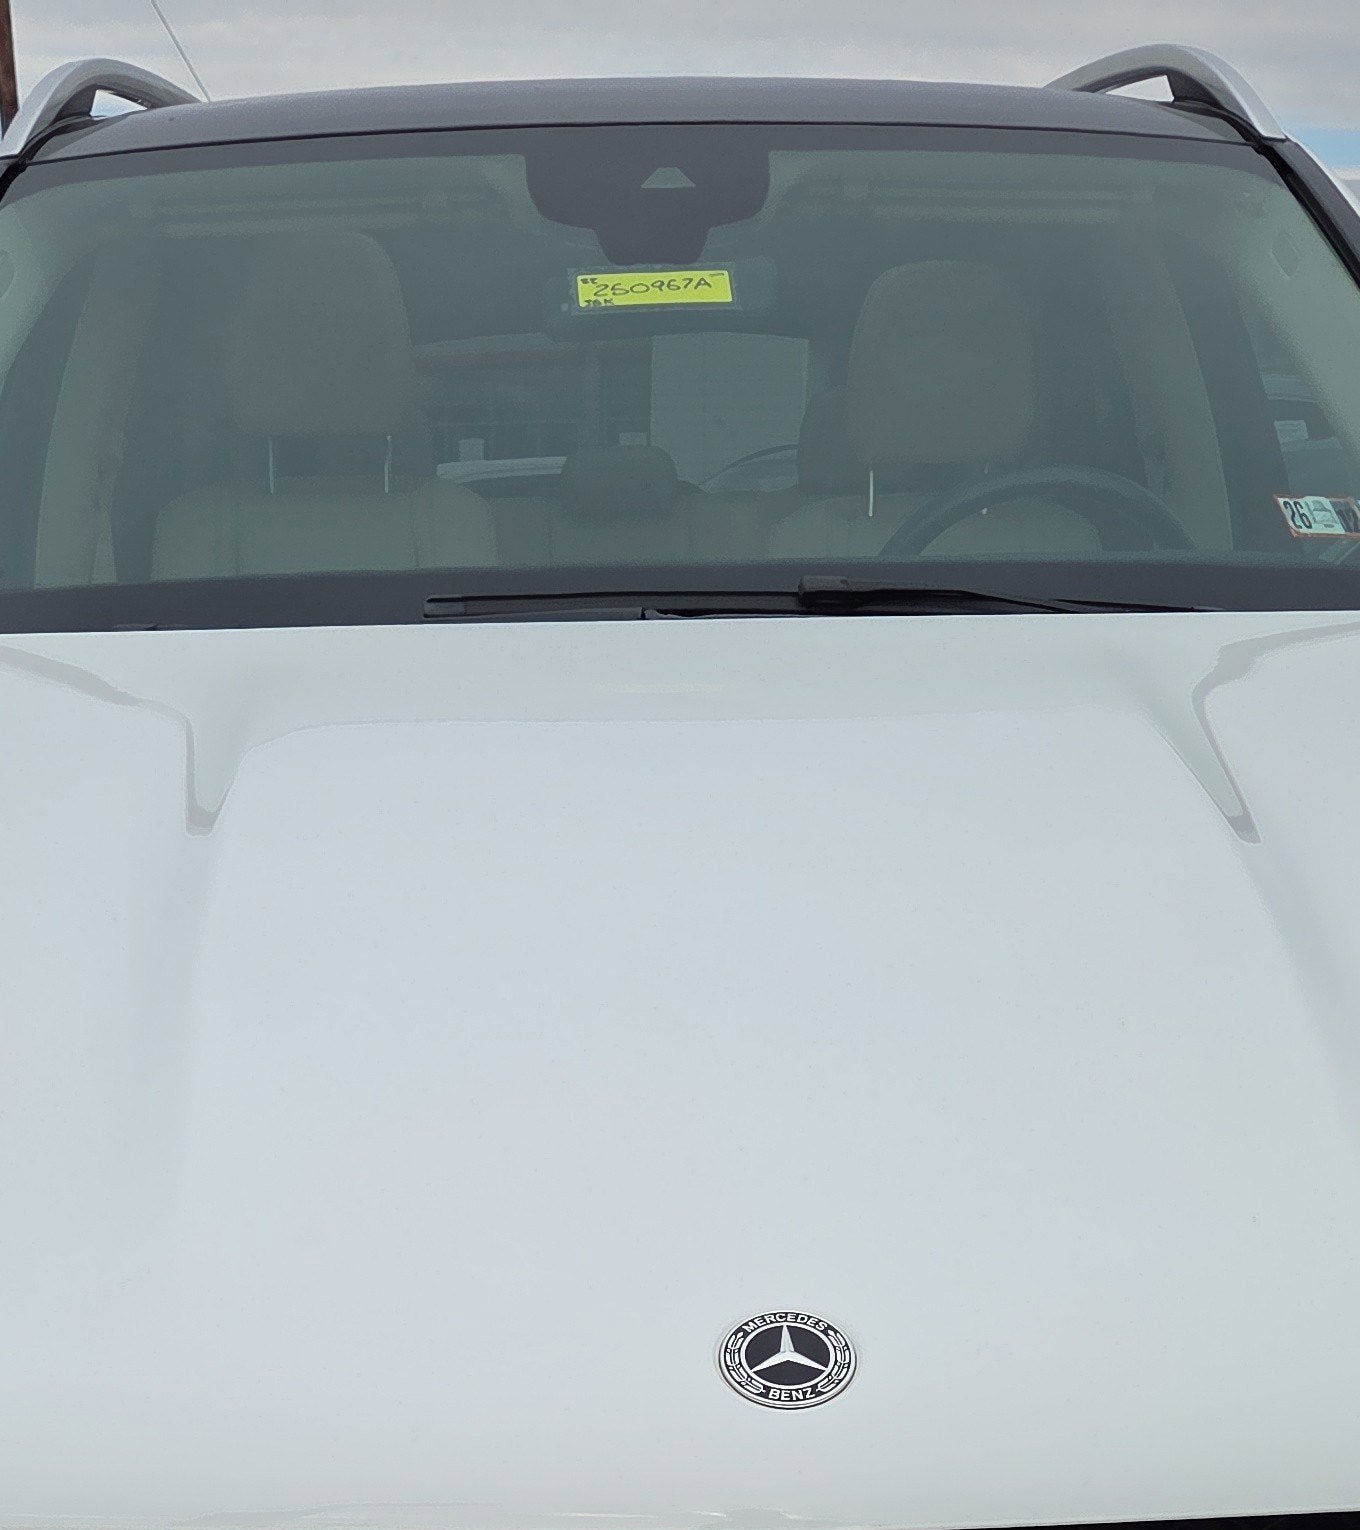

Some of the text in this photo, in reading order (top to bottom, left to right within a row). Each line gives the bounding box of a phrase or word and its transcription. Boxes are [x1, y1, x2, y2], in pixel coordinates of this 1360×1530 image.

[1282, 500, 1313, 530] 26
[742, 1313, 827, 1332] MERCEDES
[768, 1387, 816, 1401] BENZ
